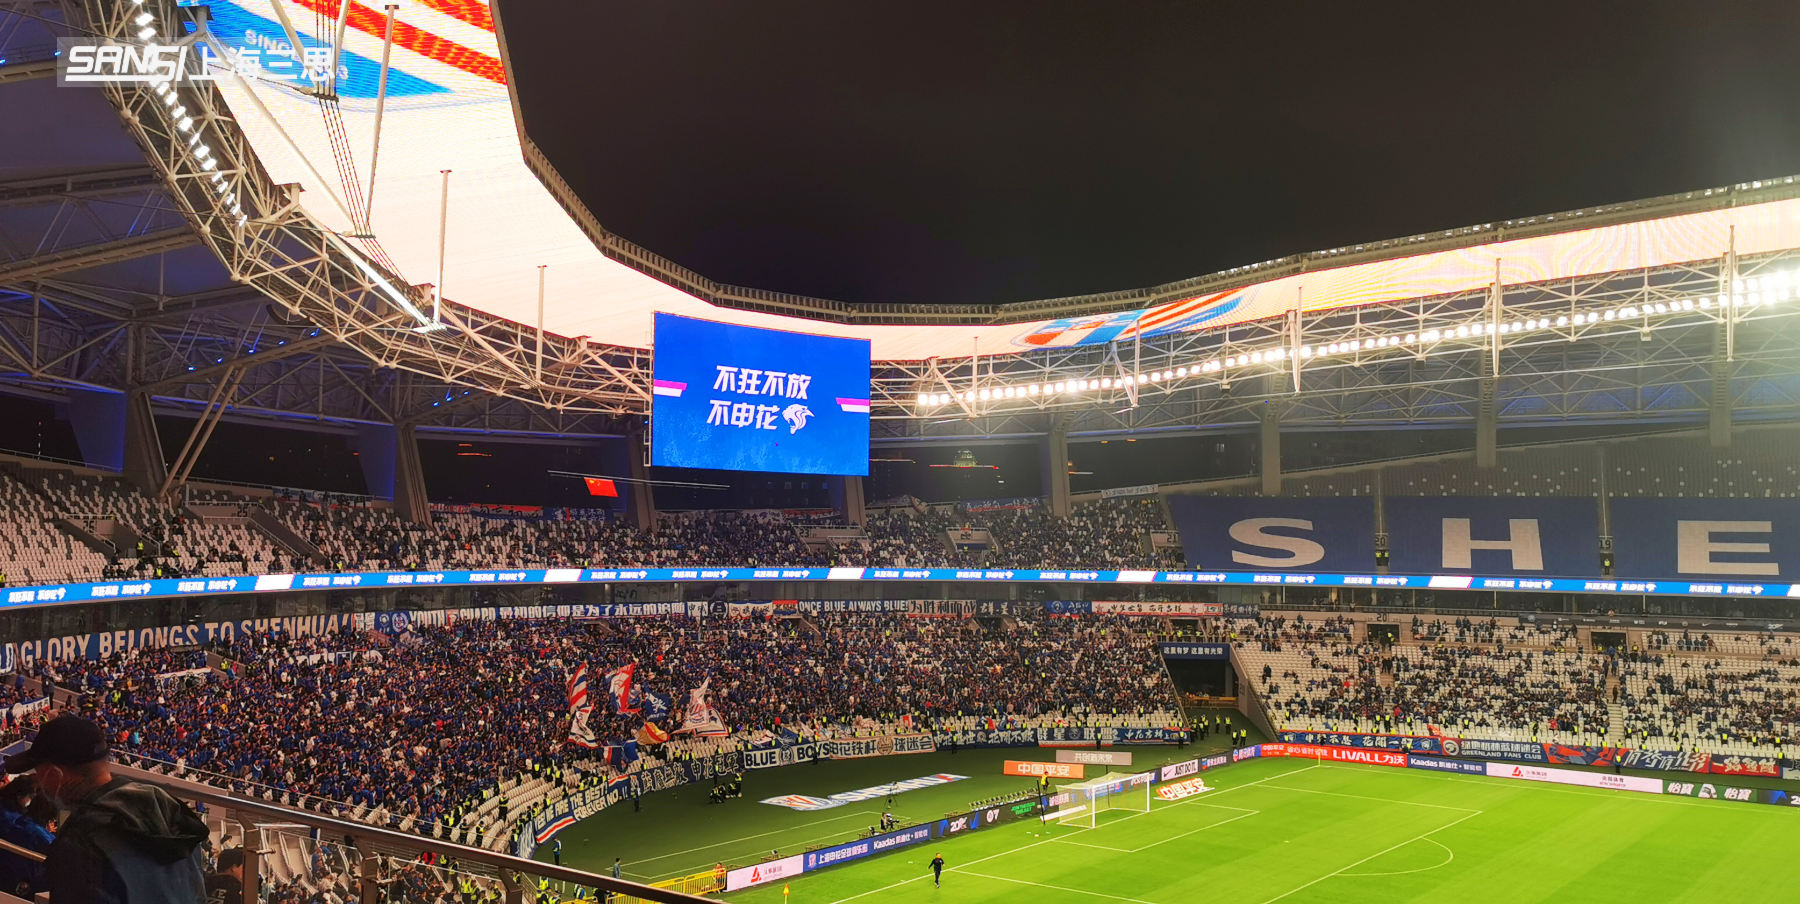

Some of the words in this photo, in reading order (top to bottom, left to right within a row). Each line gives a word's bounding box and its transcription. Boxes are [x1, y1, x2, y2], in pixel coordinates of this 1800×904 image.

[713, 365, 812, 400] 不狂不放
[706, 399, 780, 430] 不申花
[1167, 534, 1178, 543] 21
[1599, 539, 1611, 550] 19
[799, 601, 822, 612] ONCE
[848, 601, 882, 612] ALWAYS
[884, 601, 909, 611] BLUE!
[911, 600, 976, 614] 为胜利而战
[409, 610, 445, 628] YOUTH
[1377, 613, 1387, 622] 20
[21, 634, 91, 667] GLORY
[99, 624, 199, 659] BELONGS
[205, 621, 234, 645] TO
[1164, 646, 1189, 655] 这里有梦
[1191, 646, 1223, 655] 这里有光荣
[894, 736, 932, 752] 球迷会
[745, 750, 777, 767] BLUE
[1461, 750, 1501, 758] GREENLAND
[1524, 752, 1542, 760] CLUB
[1174, 763, 1185, 776] JUST
[1185, 762, 1191, 773] DO
[1410, 757, 1438, 768] Kaadas
[1018, 763, 1069, 776] 中国平安
[1667, 782, 1695, 795] 怡寶
[1724, 788, 1752, 800] 怡寶
[555, 798, 569, 817] ARE
[570, 793, 584, 810] THE
[584, 781, 608, 805] BEST!
[573, 796, 607, 821] FOREVER
[873, 838, 896, 850] Kaadas
